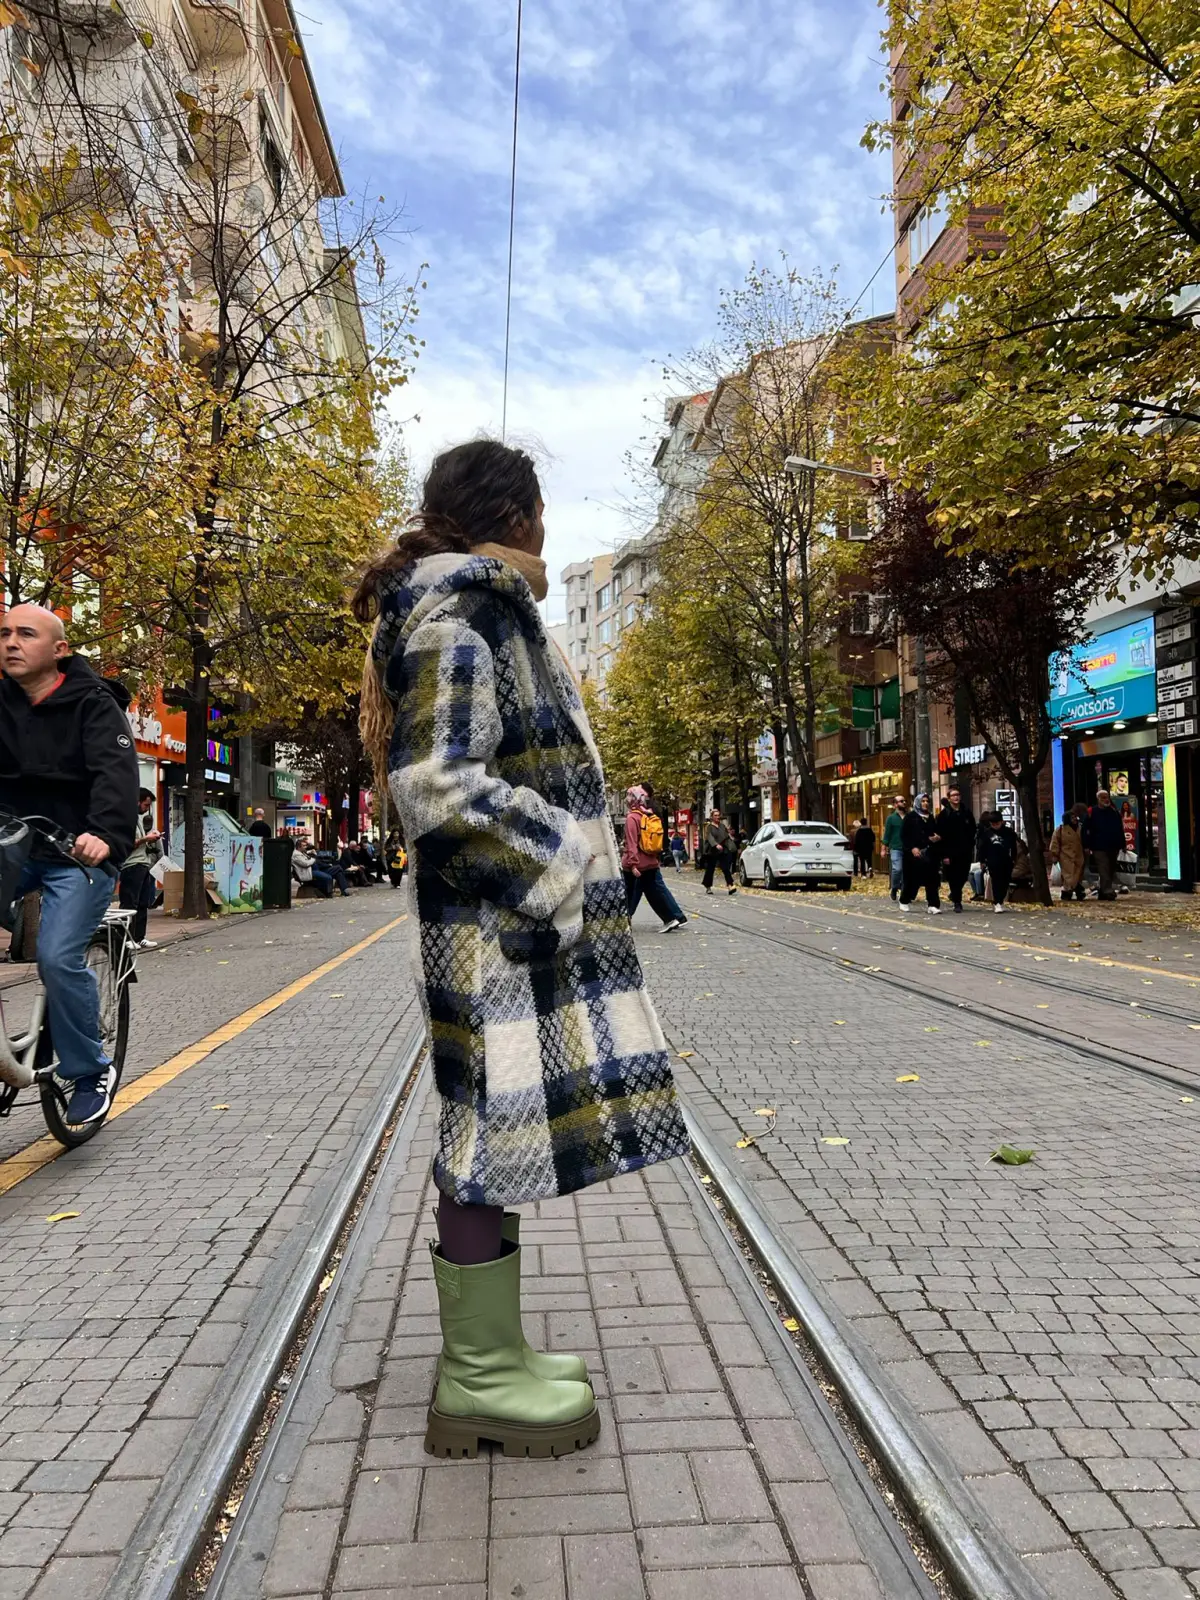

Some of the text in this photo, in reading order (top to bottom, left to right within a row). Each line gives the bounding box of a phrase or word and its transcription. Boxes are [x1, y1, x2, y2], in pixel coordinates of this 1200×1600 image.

[1067, 696, 1116, 718] watsons
[939, 744, 985, 772] IN STREET
